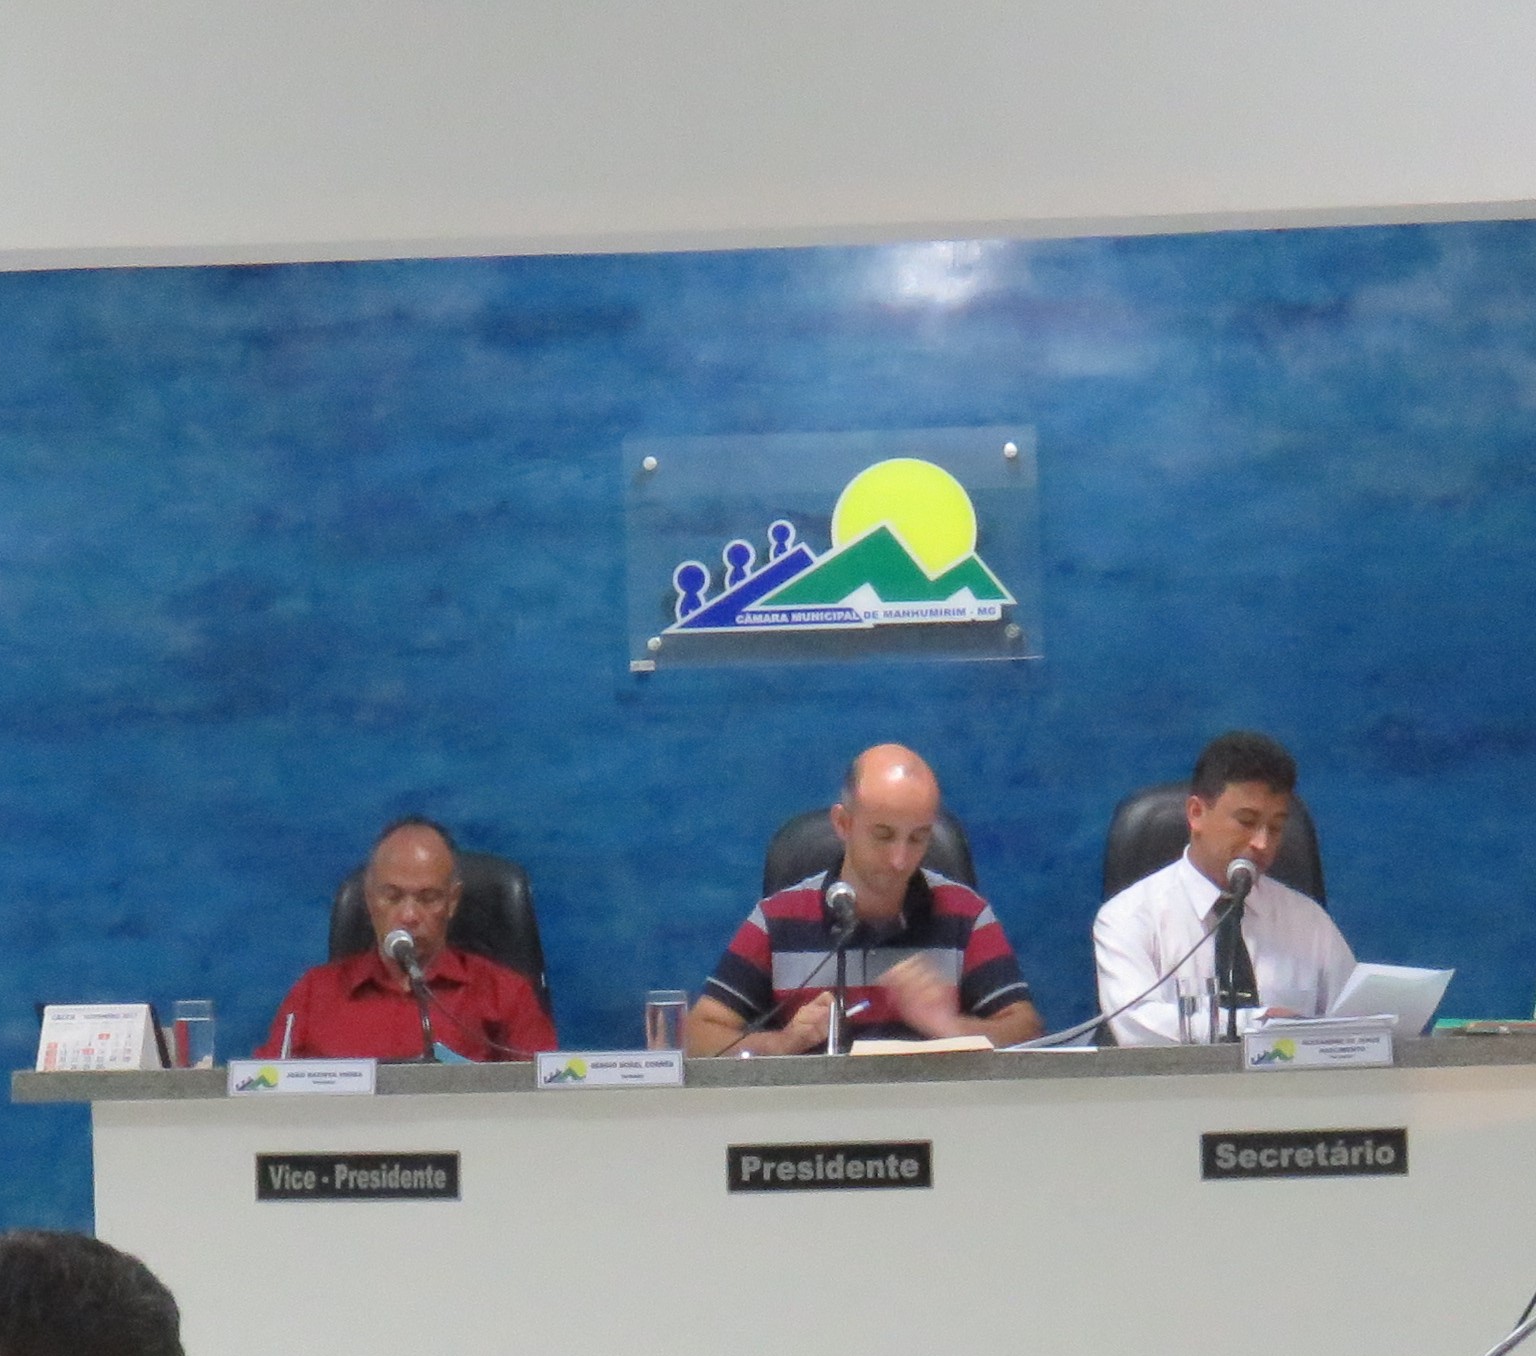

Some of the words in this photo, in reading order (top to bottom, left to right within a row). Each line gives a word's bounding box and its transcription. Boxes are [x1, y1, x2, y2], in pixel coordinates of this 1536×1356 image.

[735, 611, 789, 626] CÂMARA
[790, 609, 860, 624] MUNICIPAL
[863, 610, 879, 621] DE
[883, 607, 967, 619] MANHUMIRIM
[976, 606, 997, 617] MG
[740, 1153, 920, 1182] Presidente
[1214, 1139, 1396, 1169] Secretário
[267, 1164, 316, 1190] Vice
[333, 1162, 448, 1190] Presidente
